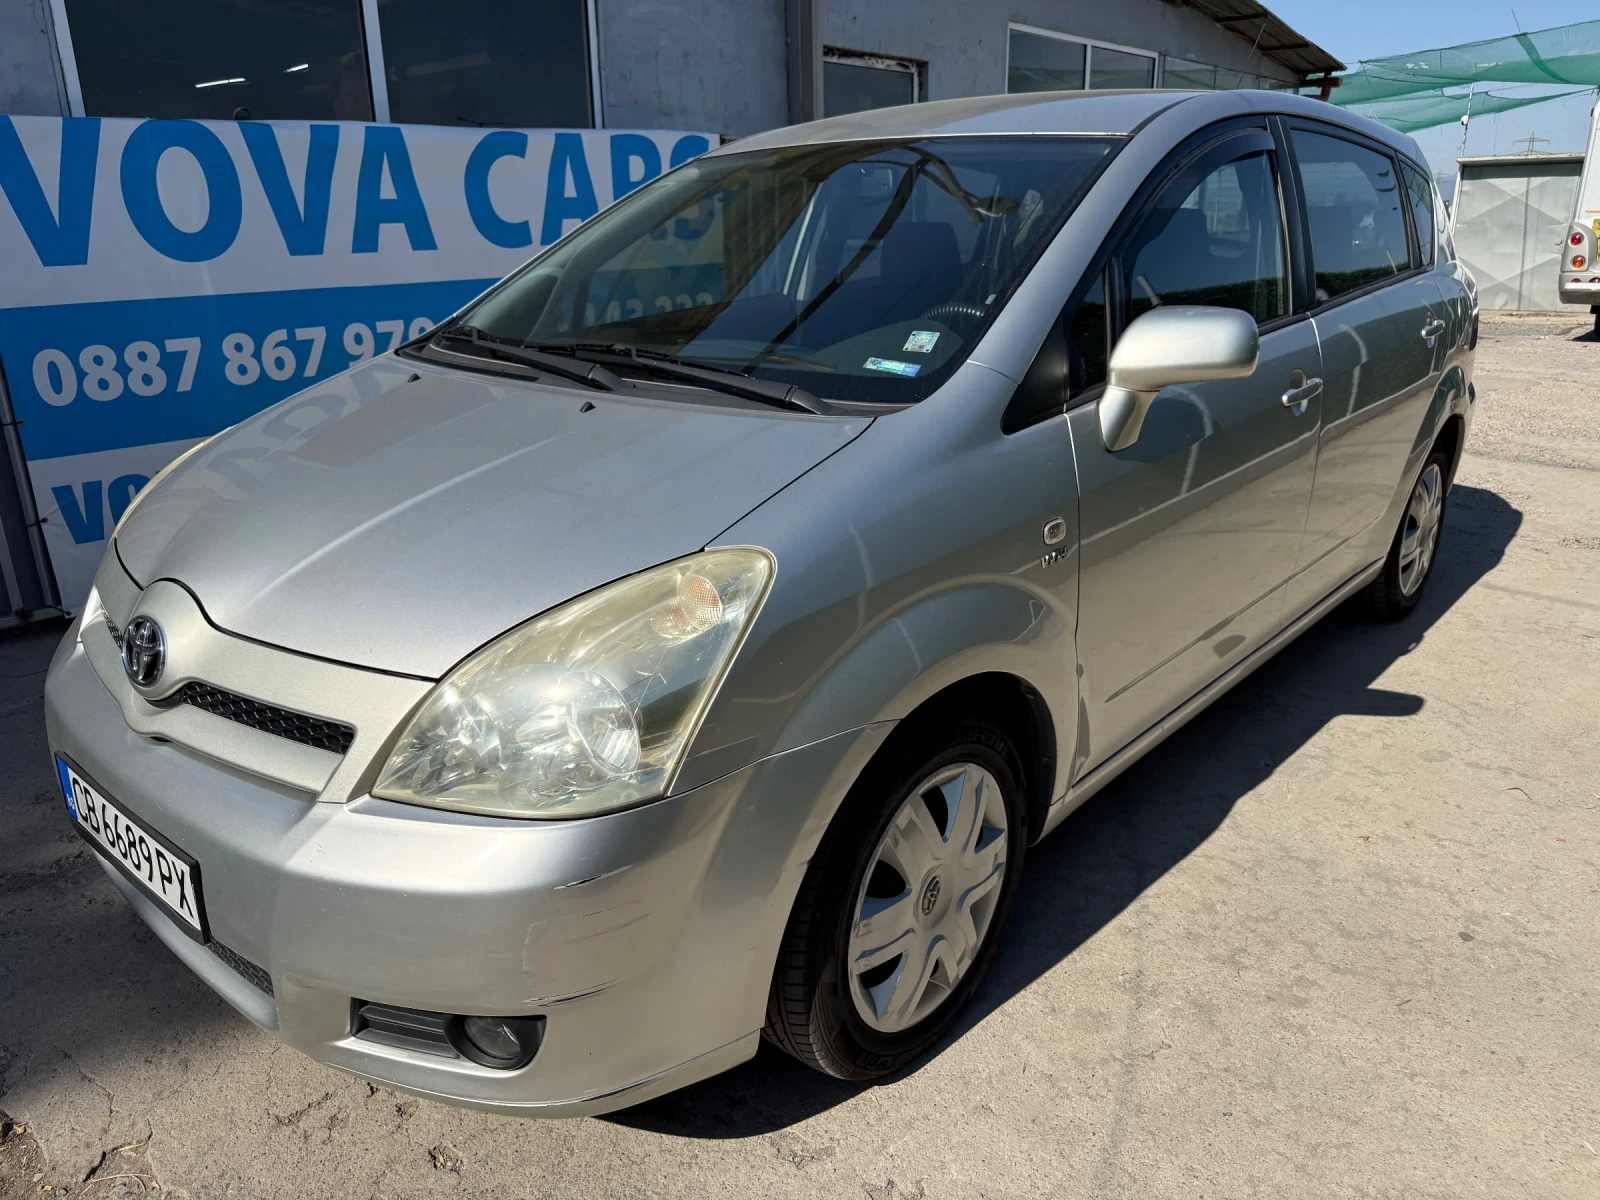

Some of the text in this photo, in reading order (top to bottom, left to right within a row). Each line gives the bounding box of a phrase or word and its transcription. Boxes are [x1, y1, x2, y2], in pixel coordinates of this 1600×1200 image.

[0, 115, 438, 267] VOVA
[32, 349, 201, 406] 0887
[222, 326, 326, 386] 867
